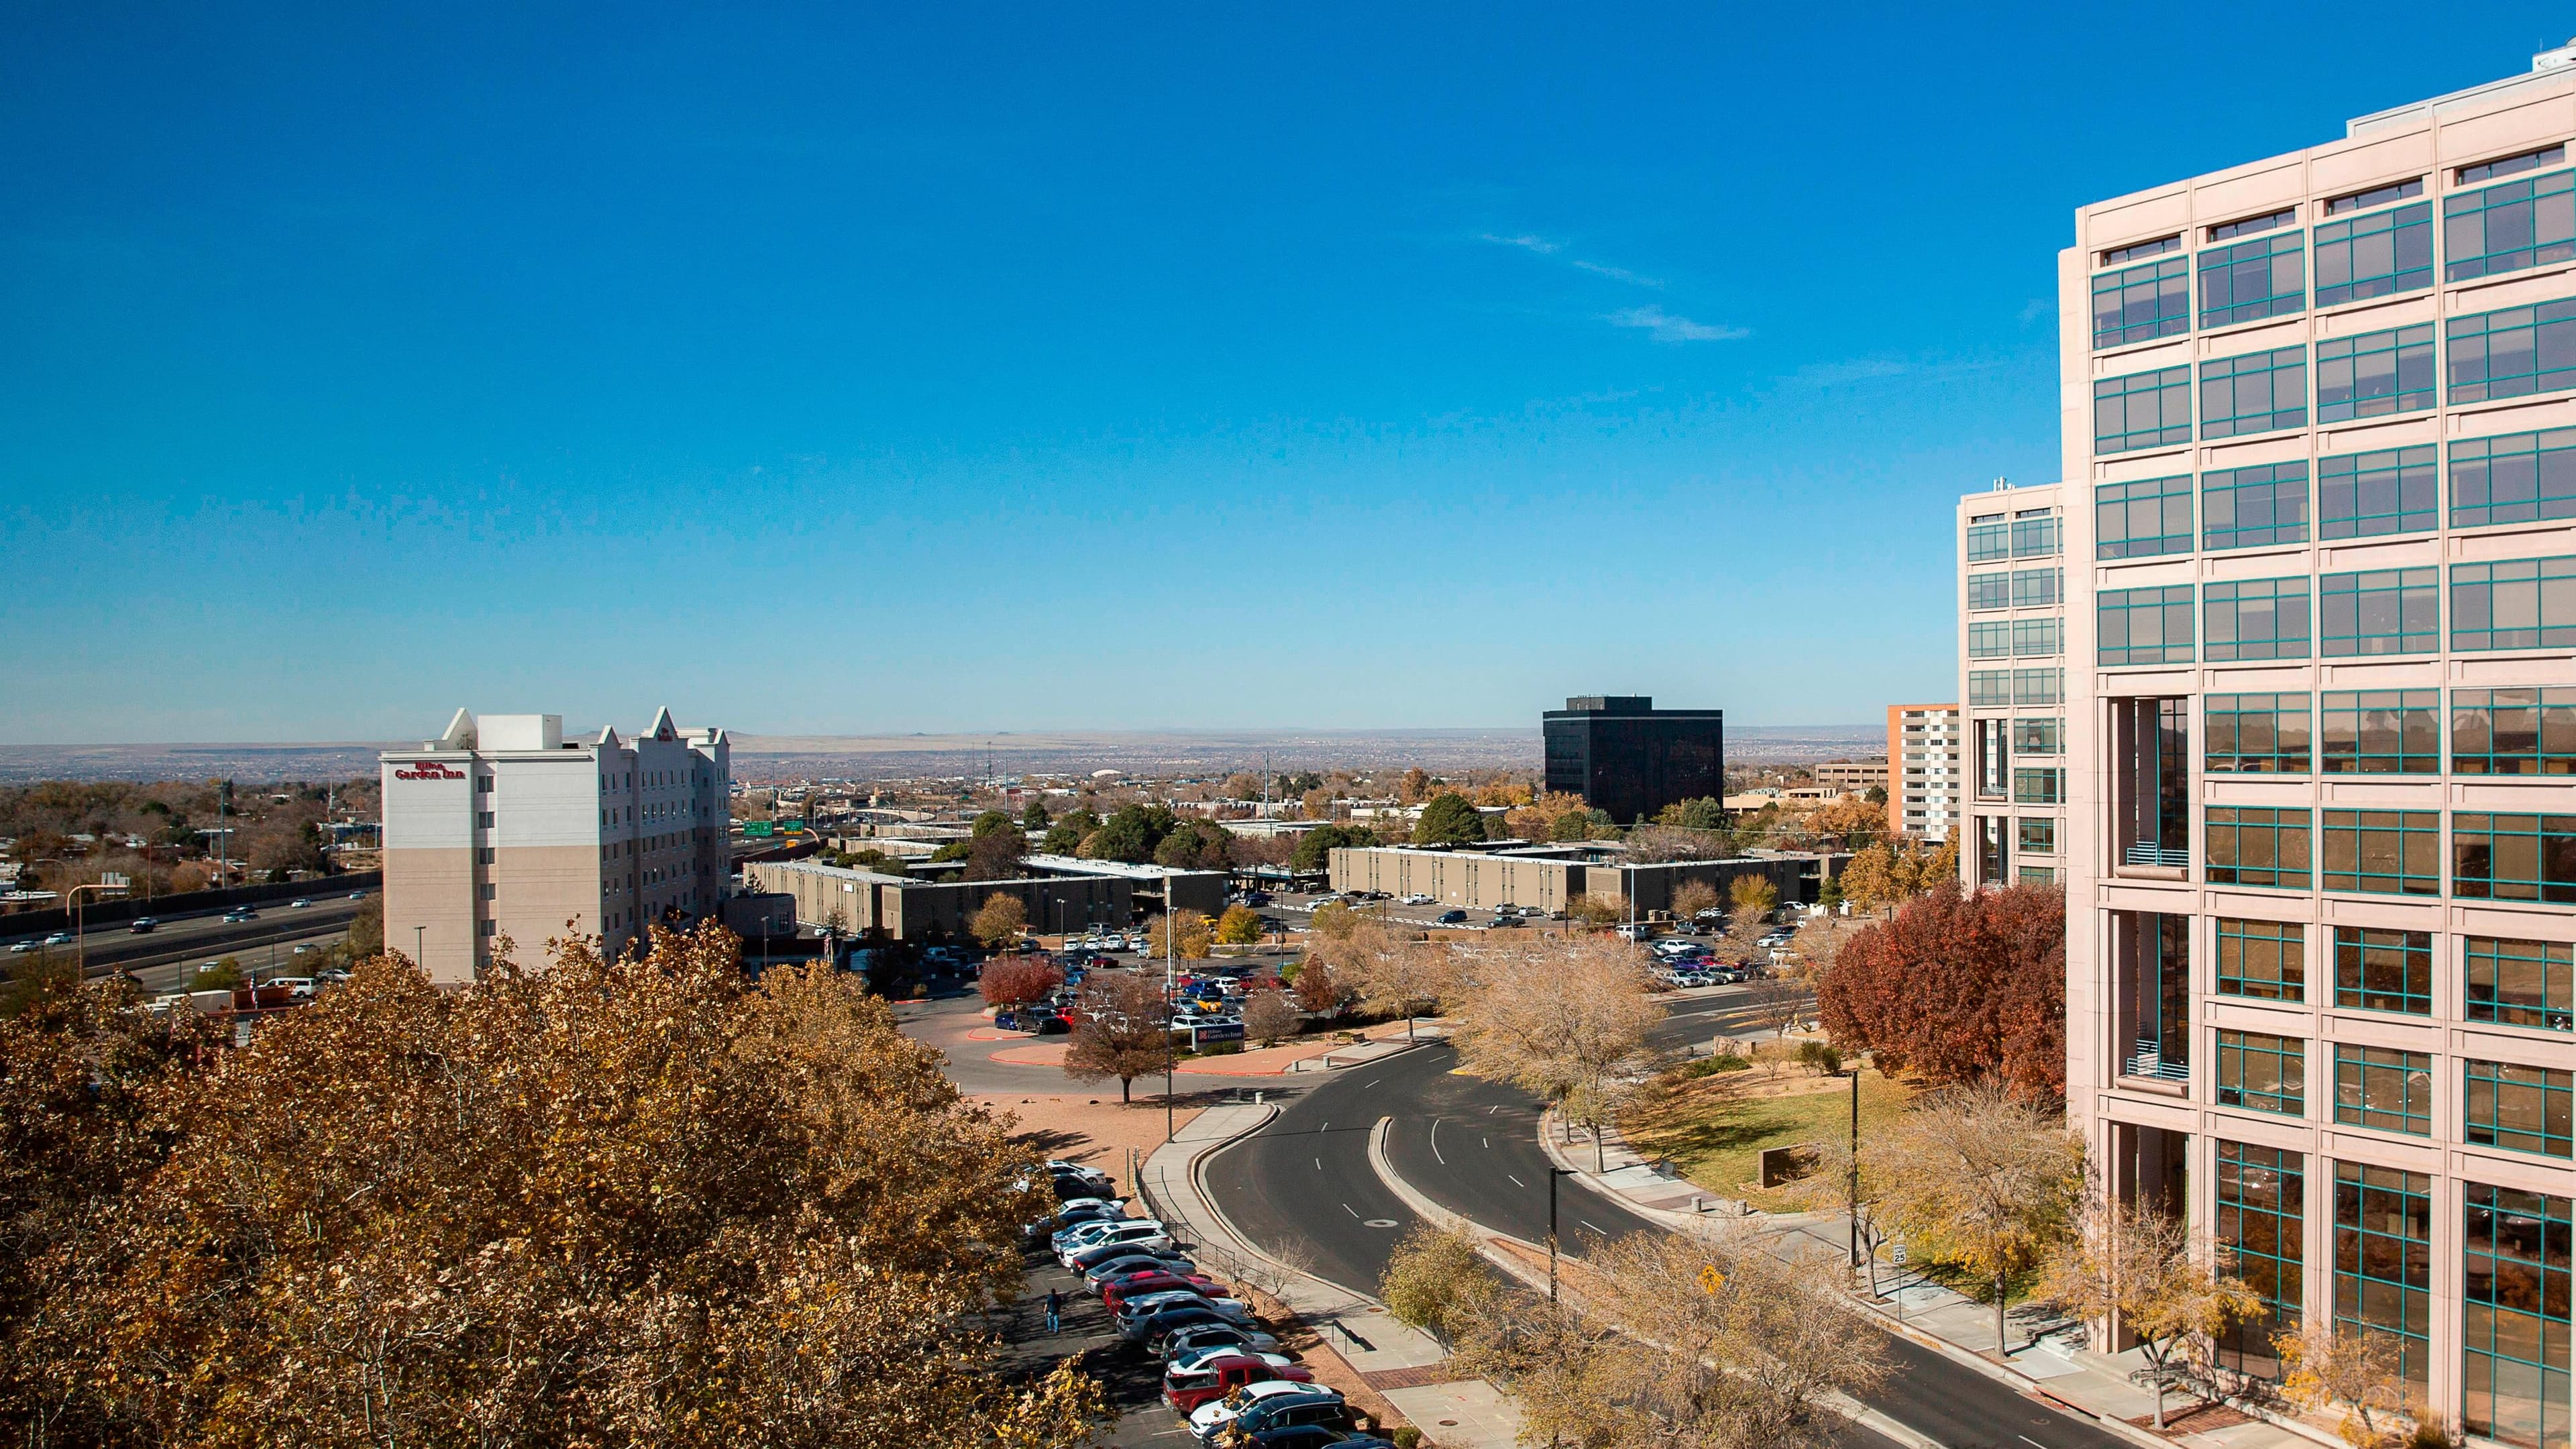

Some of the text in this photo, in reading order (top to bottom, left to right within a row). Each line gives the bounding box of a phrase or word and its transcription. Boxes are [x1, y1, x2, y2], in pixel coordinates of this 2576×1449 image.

[415, 762, 445, 770] Hilton
[395, 768, 466, 780] Garden Inn
[1895, 1254, 1905, 1262] 25
